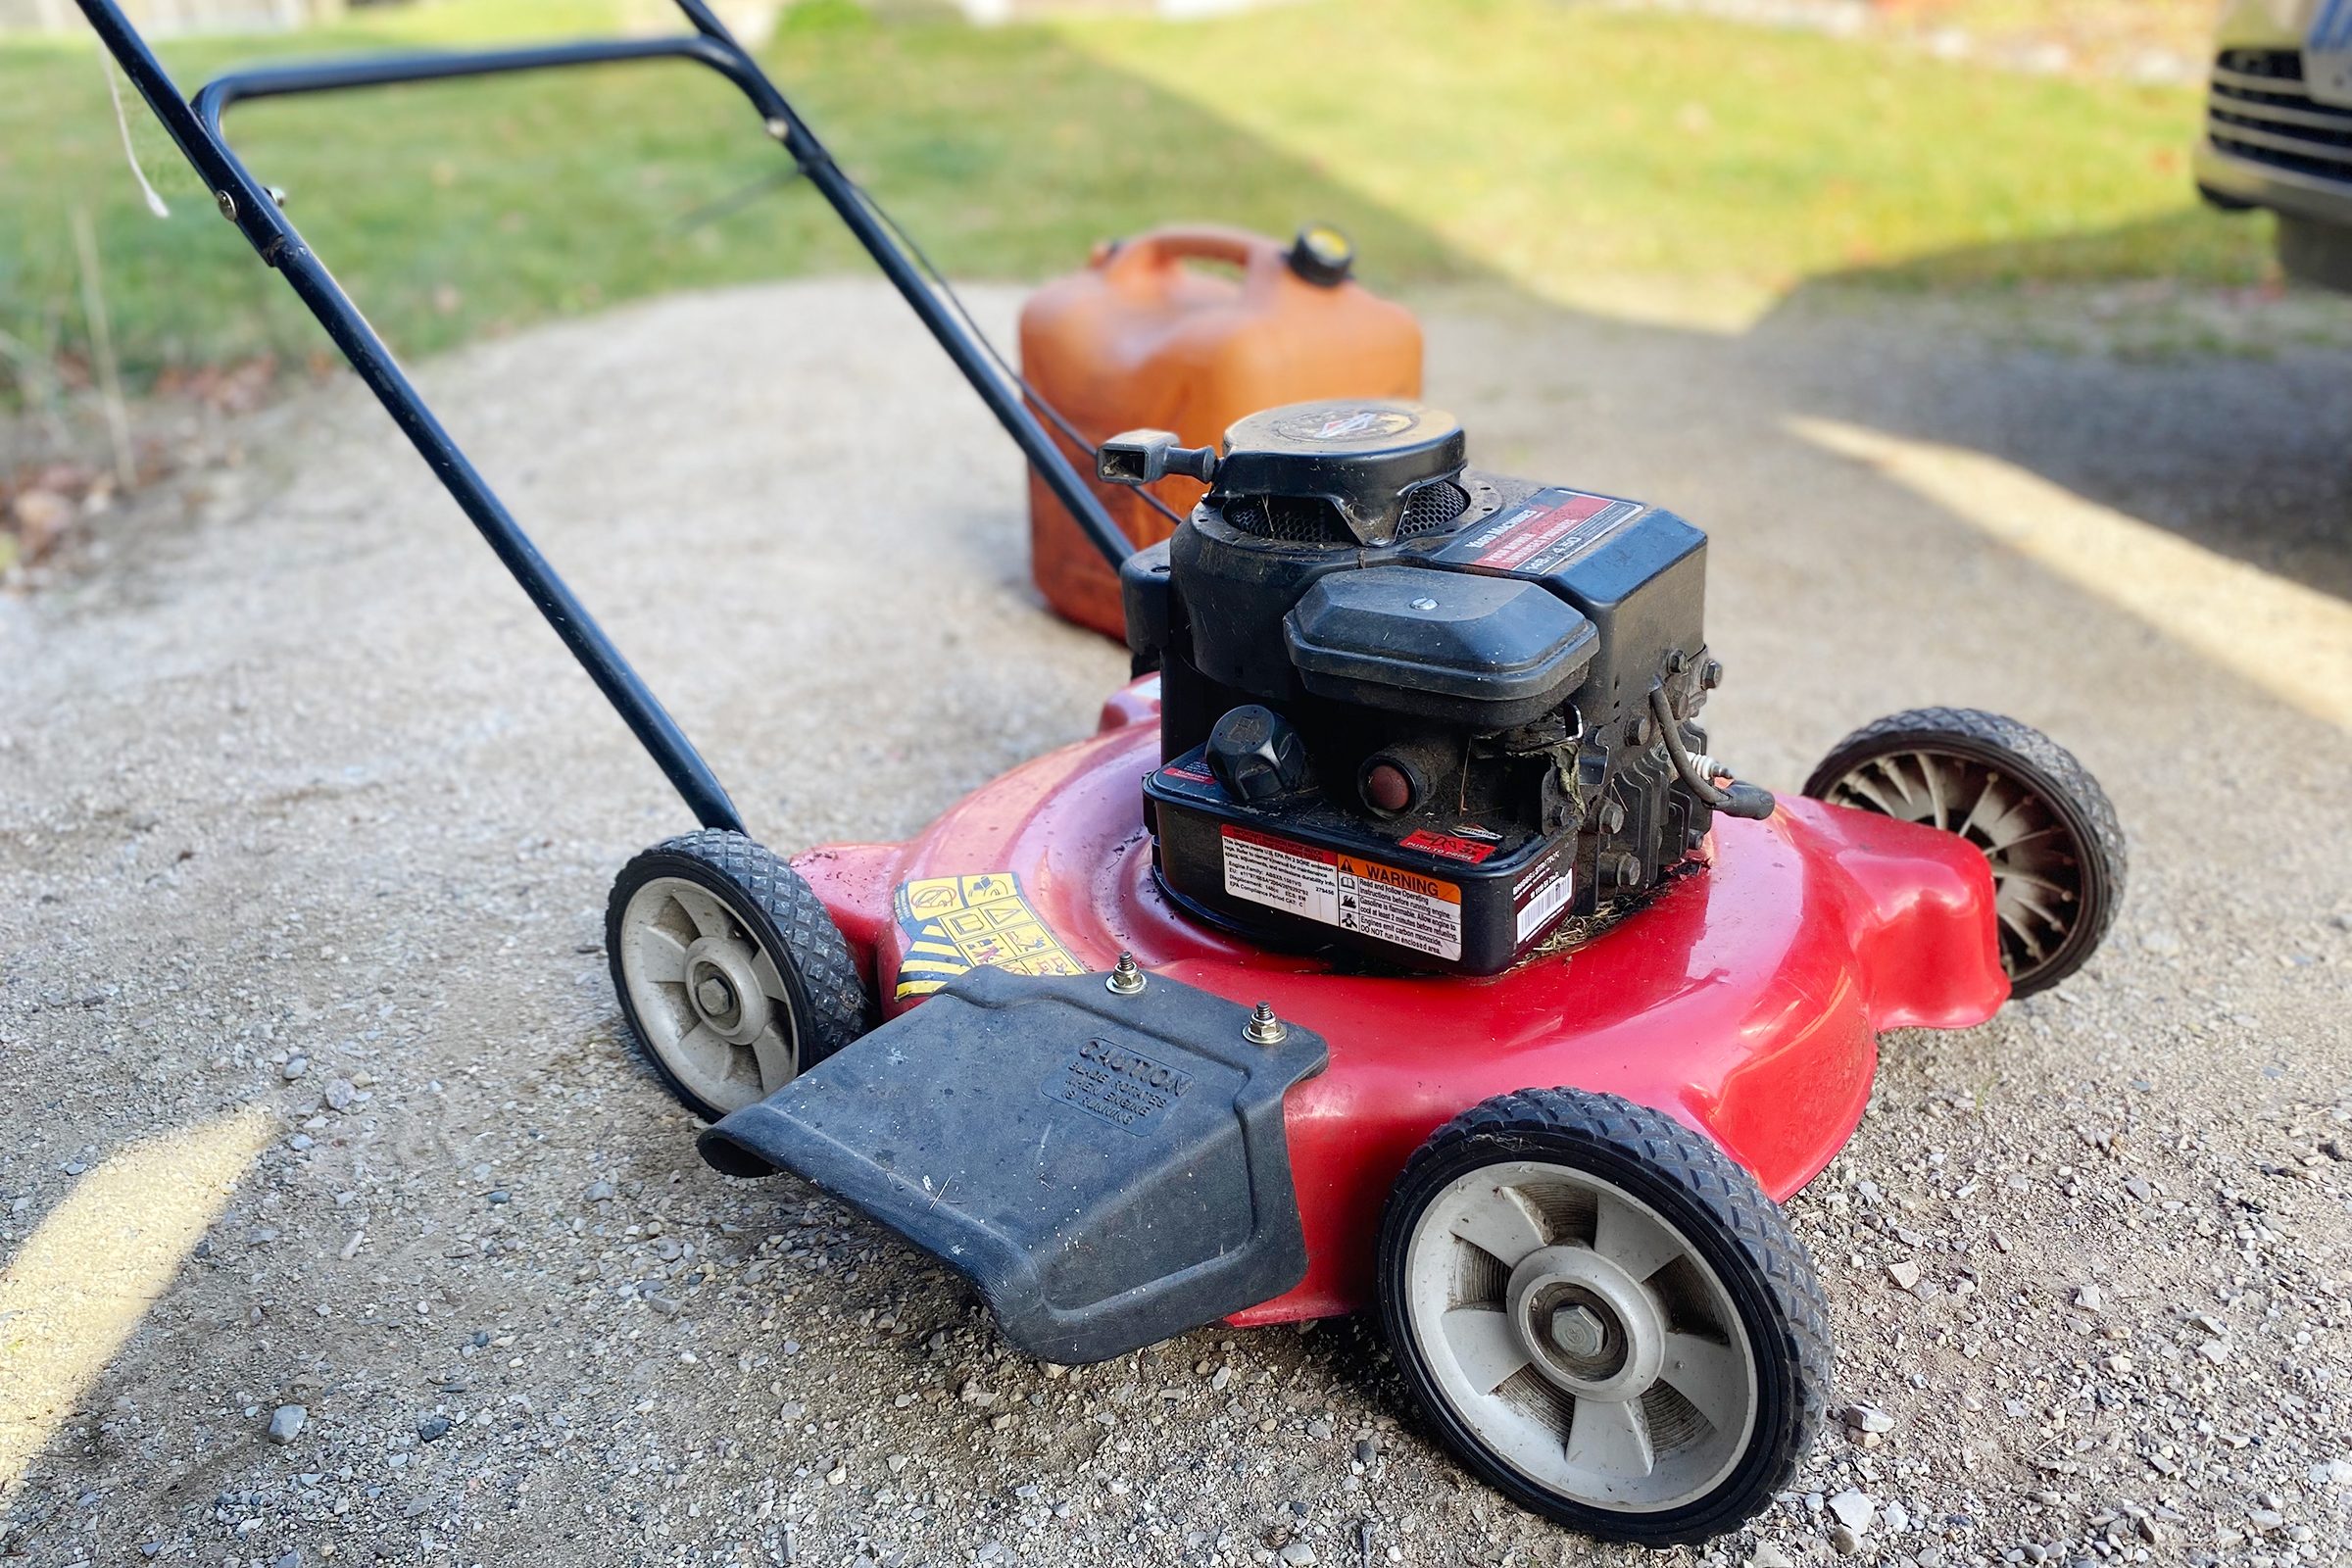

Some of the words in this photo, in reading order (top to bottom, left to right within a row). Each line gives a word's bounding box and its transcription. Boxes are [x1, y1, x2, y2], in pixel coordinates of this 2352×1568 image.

[1406, 842, 1431, 851] PUSH
[1446, 851, 1475, 860] PRIME
[1359, 879, 1373, 888] Read
[1385, 886, 1401, 897] follow
[1402, 891, 1429, 906] Operating
[1366, 863, 1439, 897] WARNING
[1359, 886, 1391, 902] Instructions
[1393, 896, 1408, 906] before
[1410, 902, 1431, 915] running
[1432, 908, 1451, 921] engine.
[1360, 897, 1382, 908] Gasoline
[1389, 906, 1416, 919] flammable.
[1417, 914, 1431, 923] Allow
[1432, 918, 1449, 932] engine
[1360, 906, 1371, 914] cool
[1378, 910, 1390, 919] least
[1396, 916, 1415, 927] minutes
[1416, 922, 1433, 933] before
[1361, 916, 1382, 929] Engines
[1383, 923, 1395, 932] emit
[1396, 926, 1414, 938] carbon
[1361, 924, 1370, 933] DO
[1371, 927, 1384, 937] NOT
[1400, 937, 1427, 951] enclosed
[1428, 945, 1441, 955] area.
[1068, 1062, 1110, 1083] BLADE
[1113, 1080, 1167, 1108] ROTATES
[1079, 1041, 1193, 1097] CAUTION
[1061, 1090, 1077, 1100] IS
[1082, 1097, 1135, 1125] RUNNING
[1064, 1080, 1102, 1097] WHEN
[1102, 1092, 1152, 1117] ENGINE
